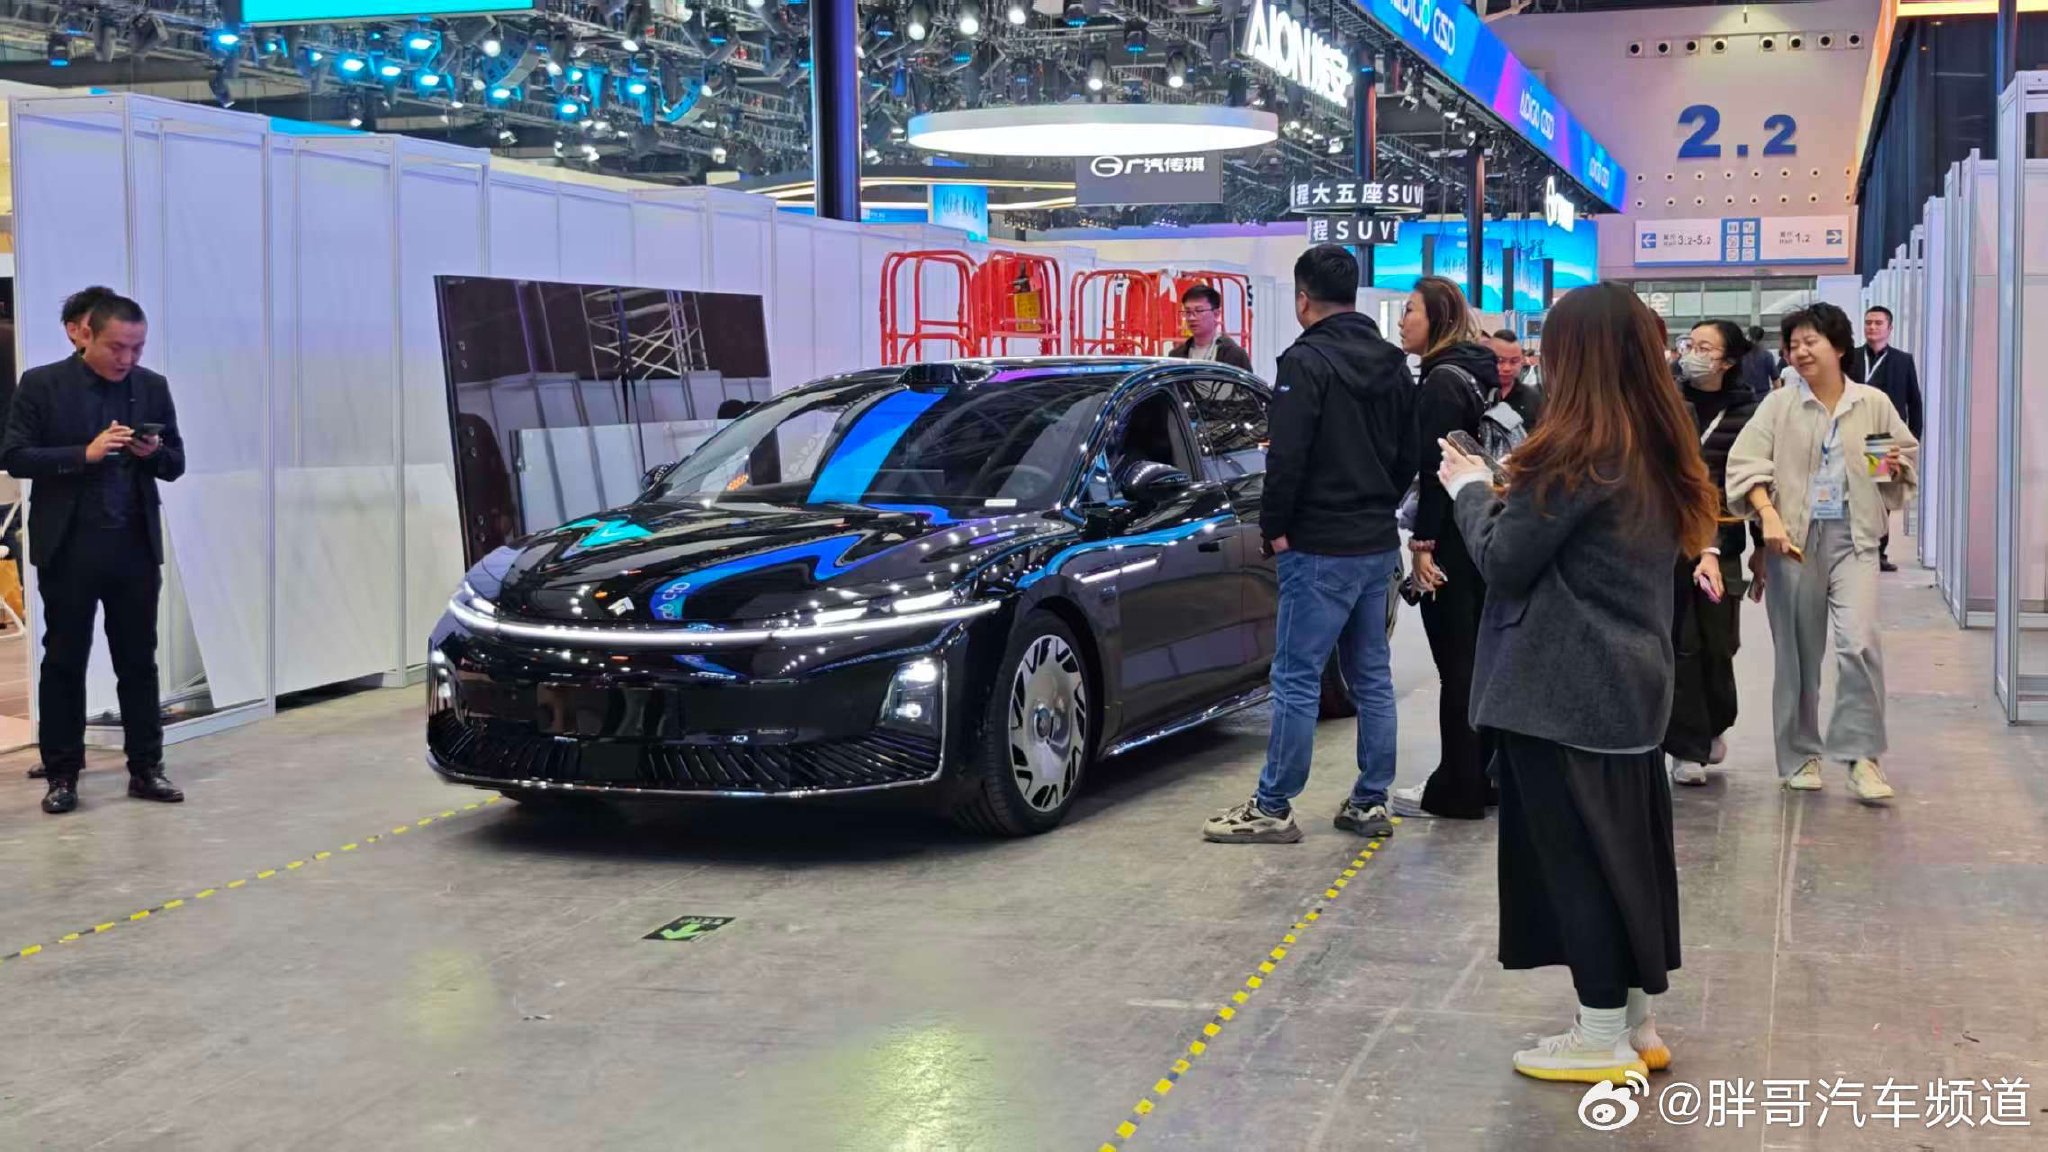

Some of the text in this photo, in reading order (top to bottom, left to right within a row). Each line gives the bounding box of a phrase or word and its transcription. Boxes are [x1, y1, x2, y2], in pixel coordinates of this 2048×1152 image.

[1247, 0, 1311, 88] AION
[1677, 104, 1798, 159] 2.2
[1124, 157, 1206, 175] 广汽传祺
[1677, 234, 1712, 246] 3.2-5.2
[1795, 232, 1811, 243] 1.2
